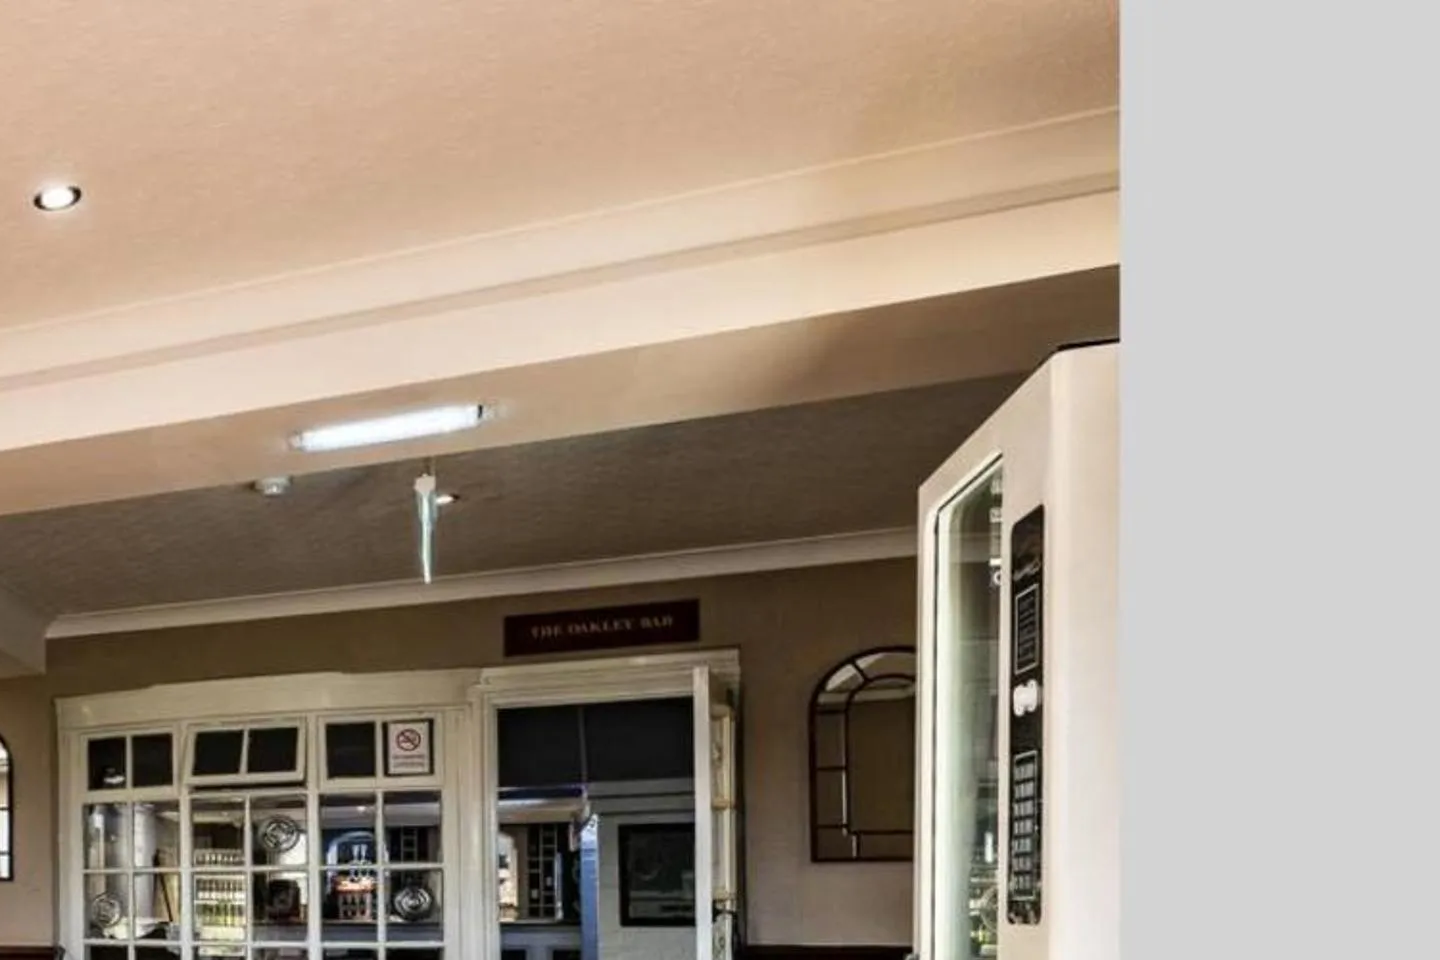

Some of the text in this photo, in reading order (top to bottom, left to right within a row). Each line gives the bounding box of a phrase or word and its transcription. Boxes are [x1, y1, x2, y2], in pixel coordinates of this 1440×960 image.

[531, 615, 674, 639] THE OAKLEY BAR
